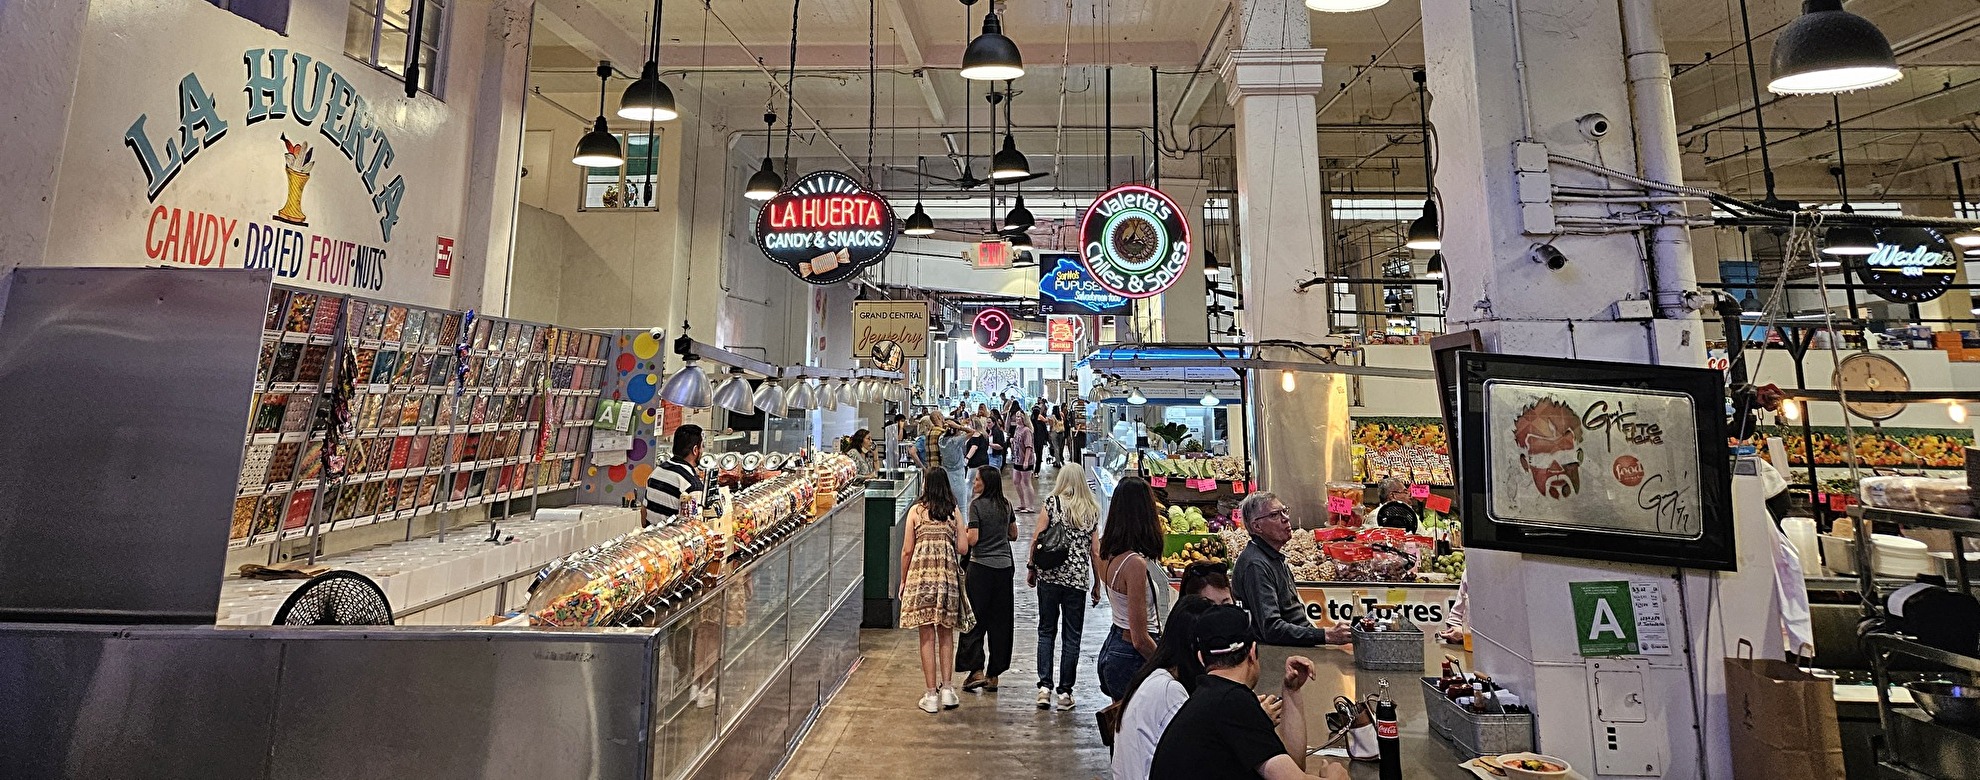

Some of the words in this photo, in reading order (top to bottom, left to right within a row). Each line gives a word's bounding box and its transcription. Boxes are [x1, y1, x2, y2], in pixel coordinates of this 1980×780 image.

[125, 72, 228, 204] LA
[243, 48, 405, 243] HUERTA
[770, 202, 797, 227] LA
[802, 198, 880, 227] HUERTA
[145, 205, 238, 268] CANDY
[244, 222, 304, 278] DRIED
[765, 232, 813, 249] CANDY
[813, 231, 826, 248] &
[828, 230, 884, 247] SNACKS
[980, 243, 1006, 266] EXIT
[1086, 241, 1124, 290] Chiles
[1127, 275, 1145, 293] &
[1144, 241, 1188, 292] Spices
[1055, 280, 1102, 291] PUPUSE
[859, 325, 923, 351] Jewelry
[599, 406, 613, 424] A
[1615, 460, 1643, 480] food
[1328, 598, 1353, 620] to
[1361, 598, 1443, 622] Torres
[1589, 598, 1626, 640] A
